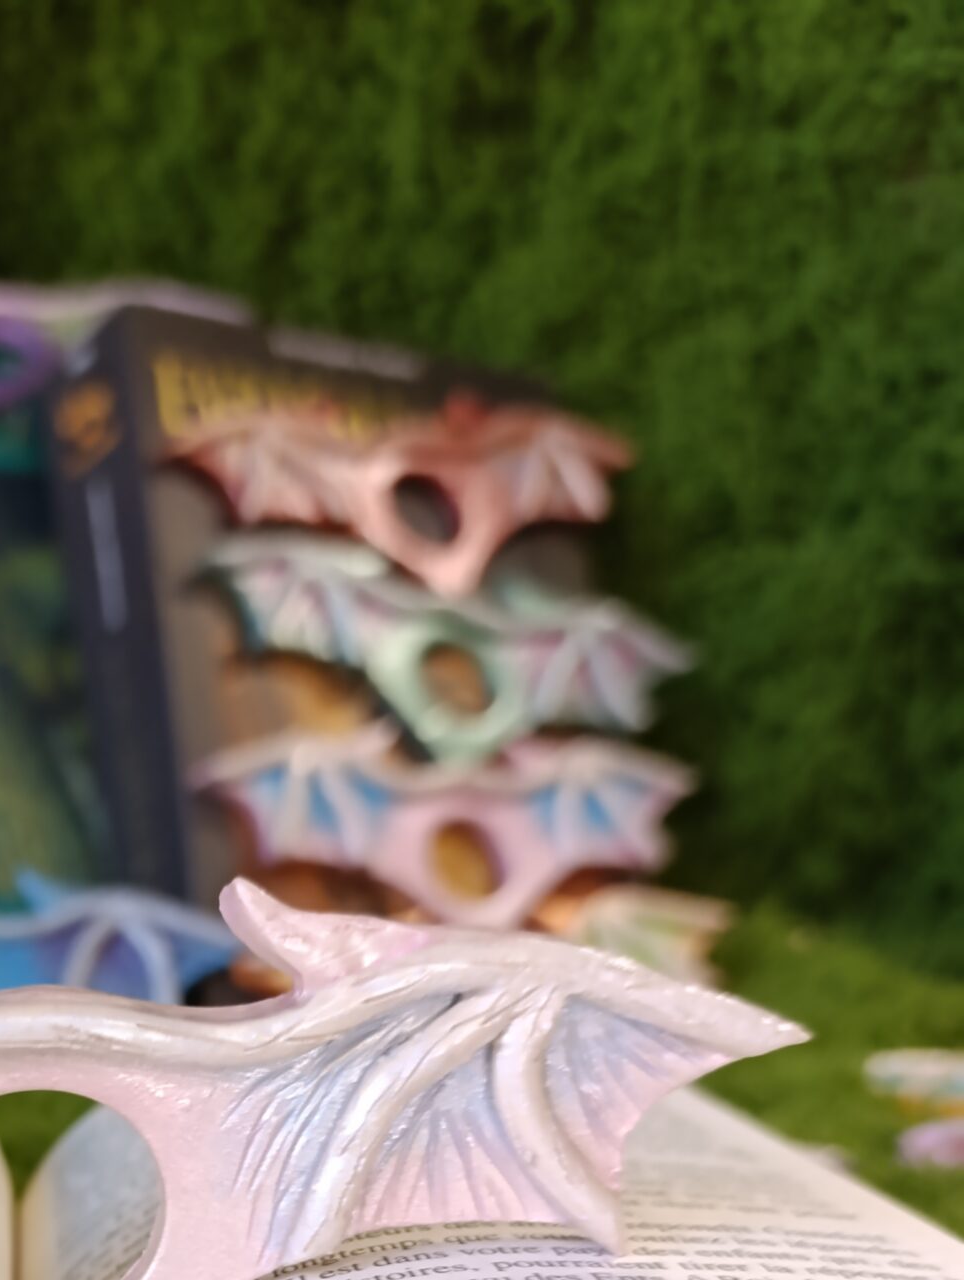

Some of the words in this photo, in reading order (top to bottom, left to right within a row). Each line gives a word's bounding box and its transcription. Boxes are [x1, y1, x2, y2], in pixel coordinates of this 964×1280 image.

[444, 1232, 500, 1246] que
[319, 1262, 364, 1280] est
[373, 1249, 449, 1267] dans
[460, 1244, 541, 1256] votre
